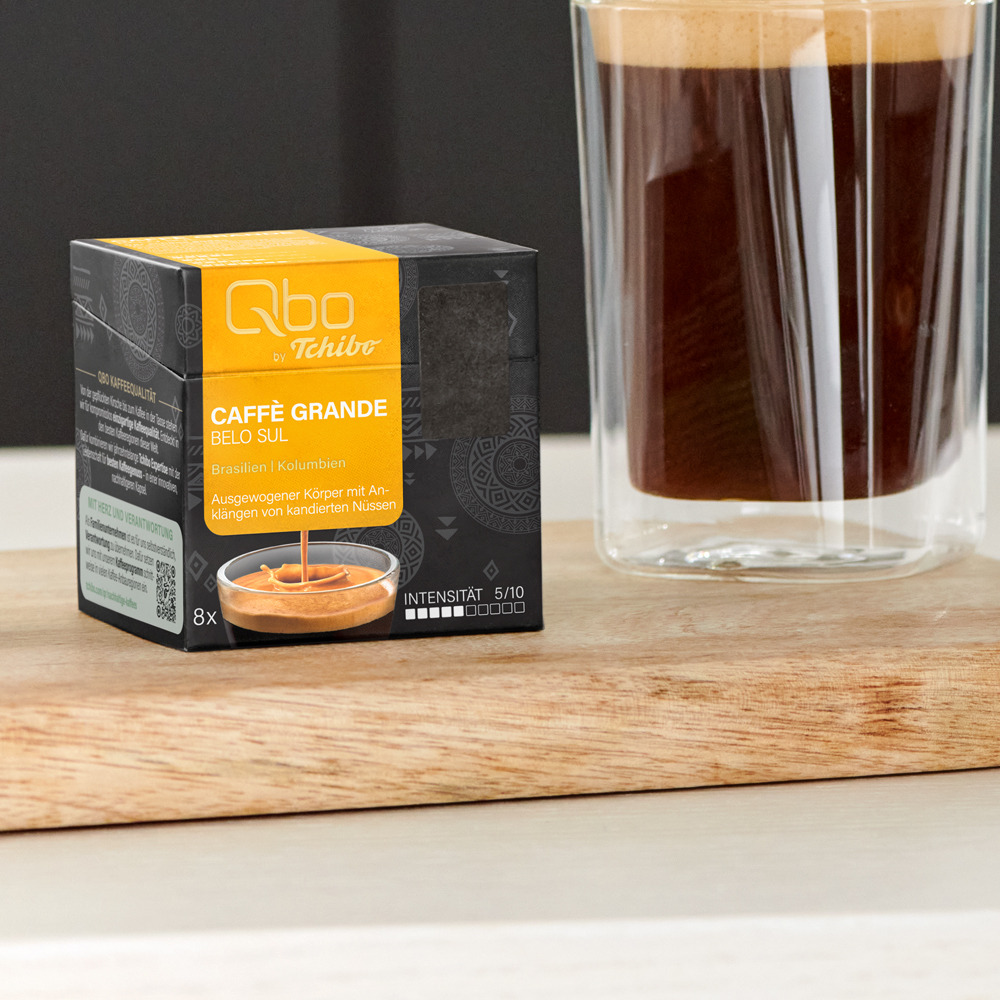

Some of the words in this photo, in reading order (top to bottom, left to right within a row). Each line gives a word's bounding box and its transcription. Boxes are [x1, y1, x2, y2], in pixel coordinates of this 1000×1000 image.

[226, 278, 354, 337] Qbo
[273, 352, 286, 362] by
[290, 334, 382, 359] Tchibo
[98, 371, 109, 385] QBO
[110, 375, 156, 403] KAFFEEQUALITÄT
[211, 400, 284, 425] CAFFÈ
[291, 399, 388, 421] GRANDE
[211, 429, 252, 446] BELO
[257, 428, 288, 443] SUL
[212, 462, 266, 475] Brasilien
[278, 458, 346, 471] Kolumbien
[211, 491, 300, 506] Ausgewogener
[304, 488, 343, 500] Körper
[347, 485, 365, 497] mit
[368, 485, 390, 496] An-
[88, 497, 97, 510] MIT
[98, 501, 112, 516] HERZ
[113, 507, 124, 521] UND
[125, 512, 173, 541] VERANTWORTUNG
[212, 507, 257, 521] klängen
[262, 507, 282, 517] von
[287, 502, 349, 515] kandierten
[352, 500, 396, 512] Nüssen
[404, 588, 483, 605] INTENSITÄT
[494, 586, 525, 600] 5/10
[193, 608, 217, 626] 8x
